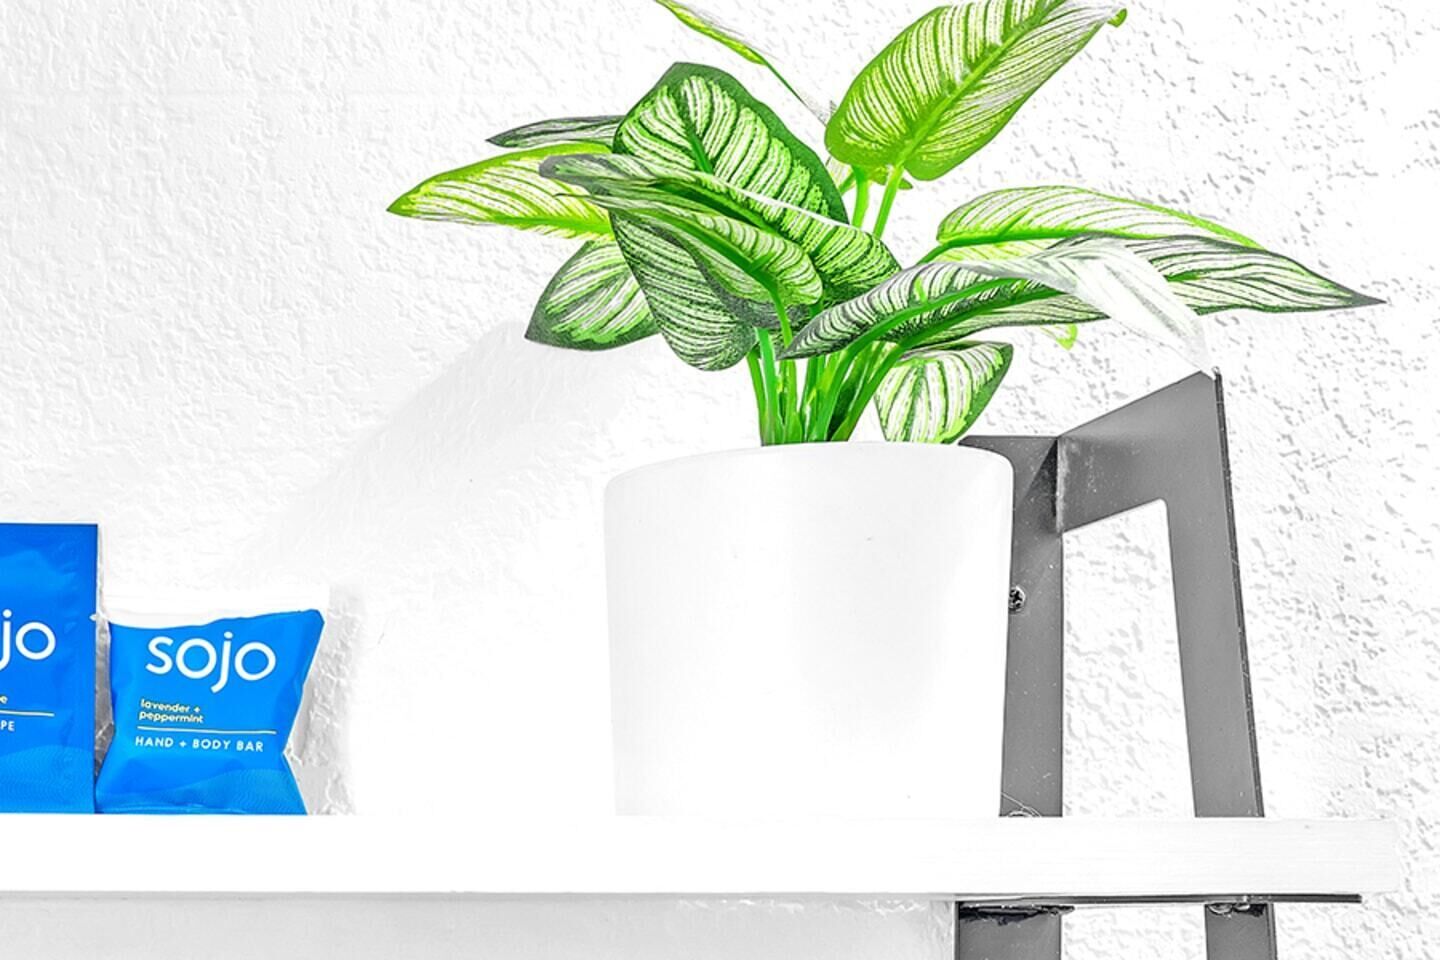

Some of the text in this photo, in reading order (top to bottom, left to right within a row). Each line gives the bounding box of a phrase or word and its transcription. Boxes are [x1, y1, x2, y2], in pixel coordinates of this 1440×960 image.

[145, 631, 276, 693] sojo
[140, 698, 191, 713] lavender
[138, 709, 204, 724] peppermint
[135, 736, 174, 748] HAND
[192, 738, 230, 750] BODY
[236, 740, 264, 753] BAR
